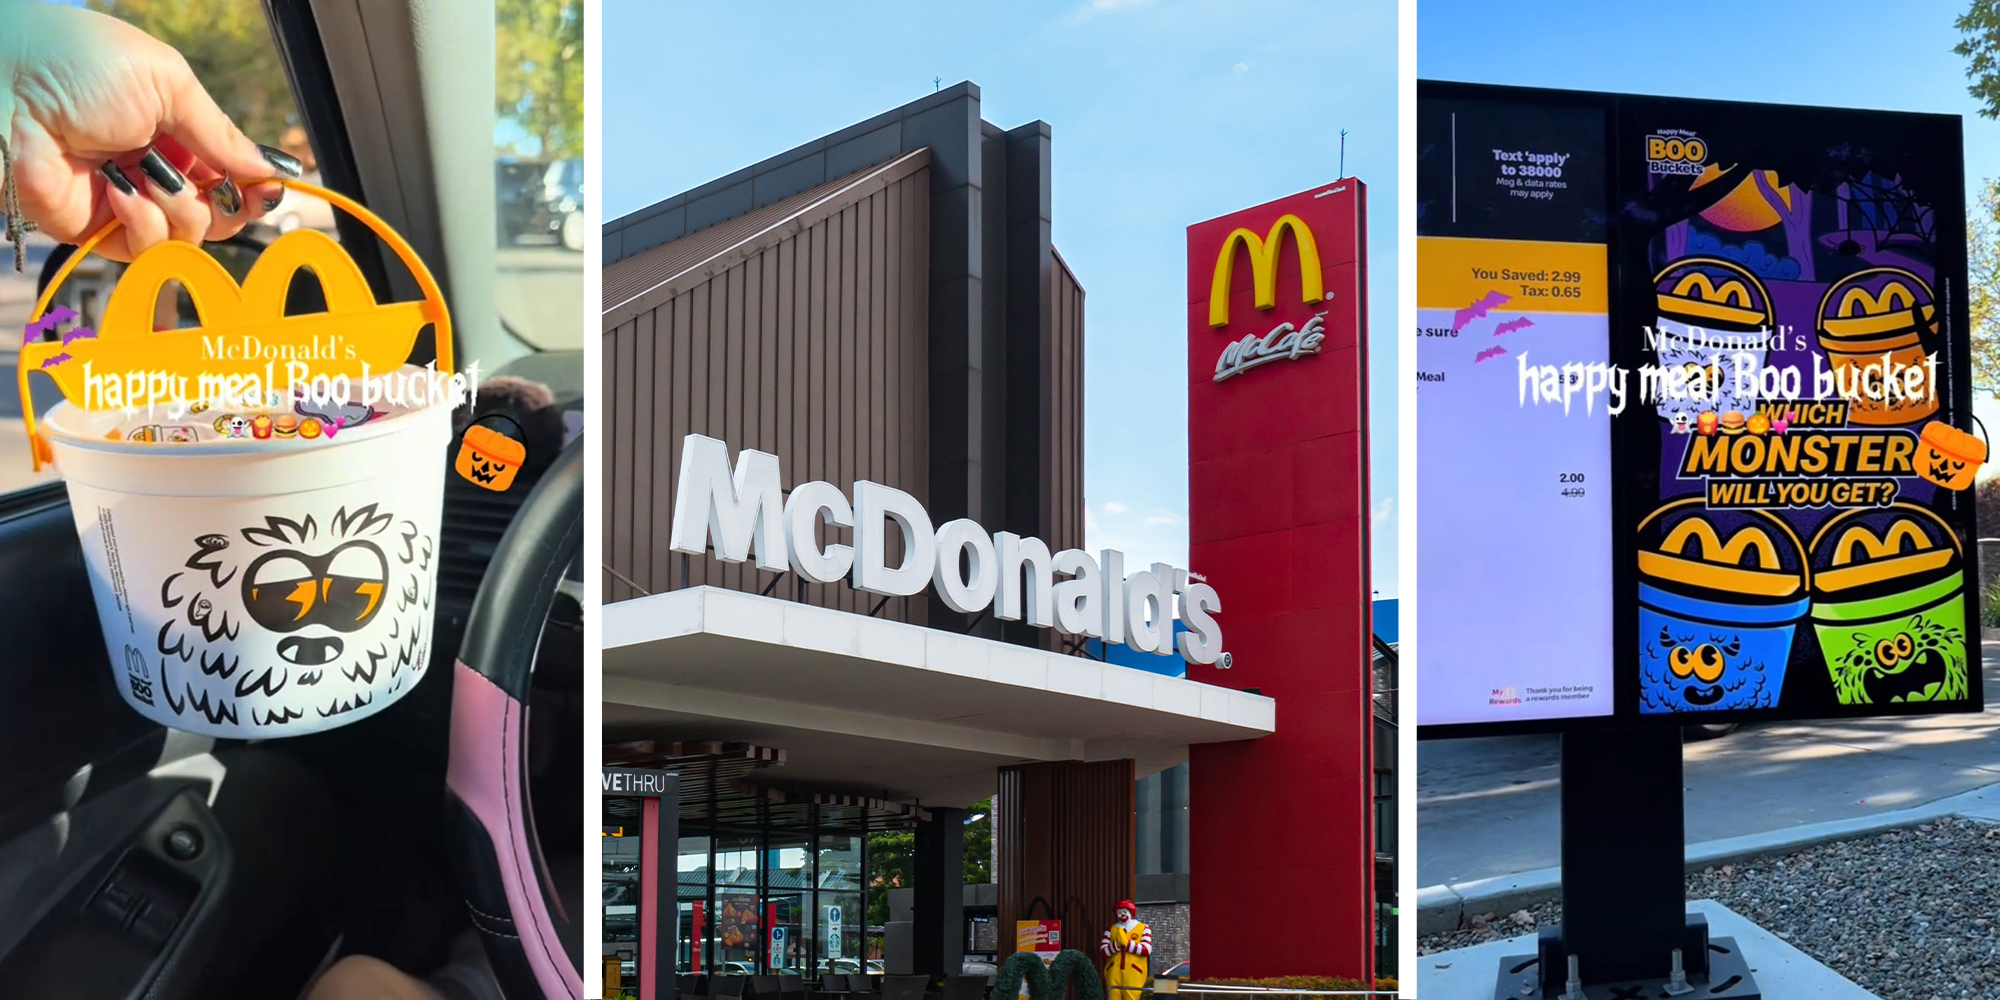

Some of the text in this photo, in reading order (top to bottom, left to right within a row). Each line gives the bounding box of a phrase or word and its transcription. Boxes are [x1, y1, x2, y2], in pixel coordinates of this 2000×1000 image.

[1492, 149, 1523, 162] Text
[1648, 137, 1705, 162] BOO
[1501, 164, 1562, 178] to 38000
[1651, 161, 1704, 174] Buckets
[1496, 177, 1567, 188] Msg & data rates
[1510, 189, 1554, 200] may apply
[1471, 267, 1581, 282] You Saved: 2.99
[1520, 285, 1581, 298] Tax: 0.65
[1425, 328, 1459, 338] sure
[1685, 435, 1914, 474] MONSTER
[1560, 472, 1585, 483] 2.00
[1561, 487, 1585, 498] 4.99
[1711, 481, 1895, 504] WILL YOU GET?
[670, 433, 1223, 665] McDonald's
[1526, 686, 1548, 694] Thank
[1549, 686, 1562, 694] you
[1573, 685, 1593, 693] being
[1489, 697, 1522, 705] Rewards
[1531, 694, 1559, 702] rewards
